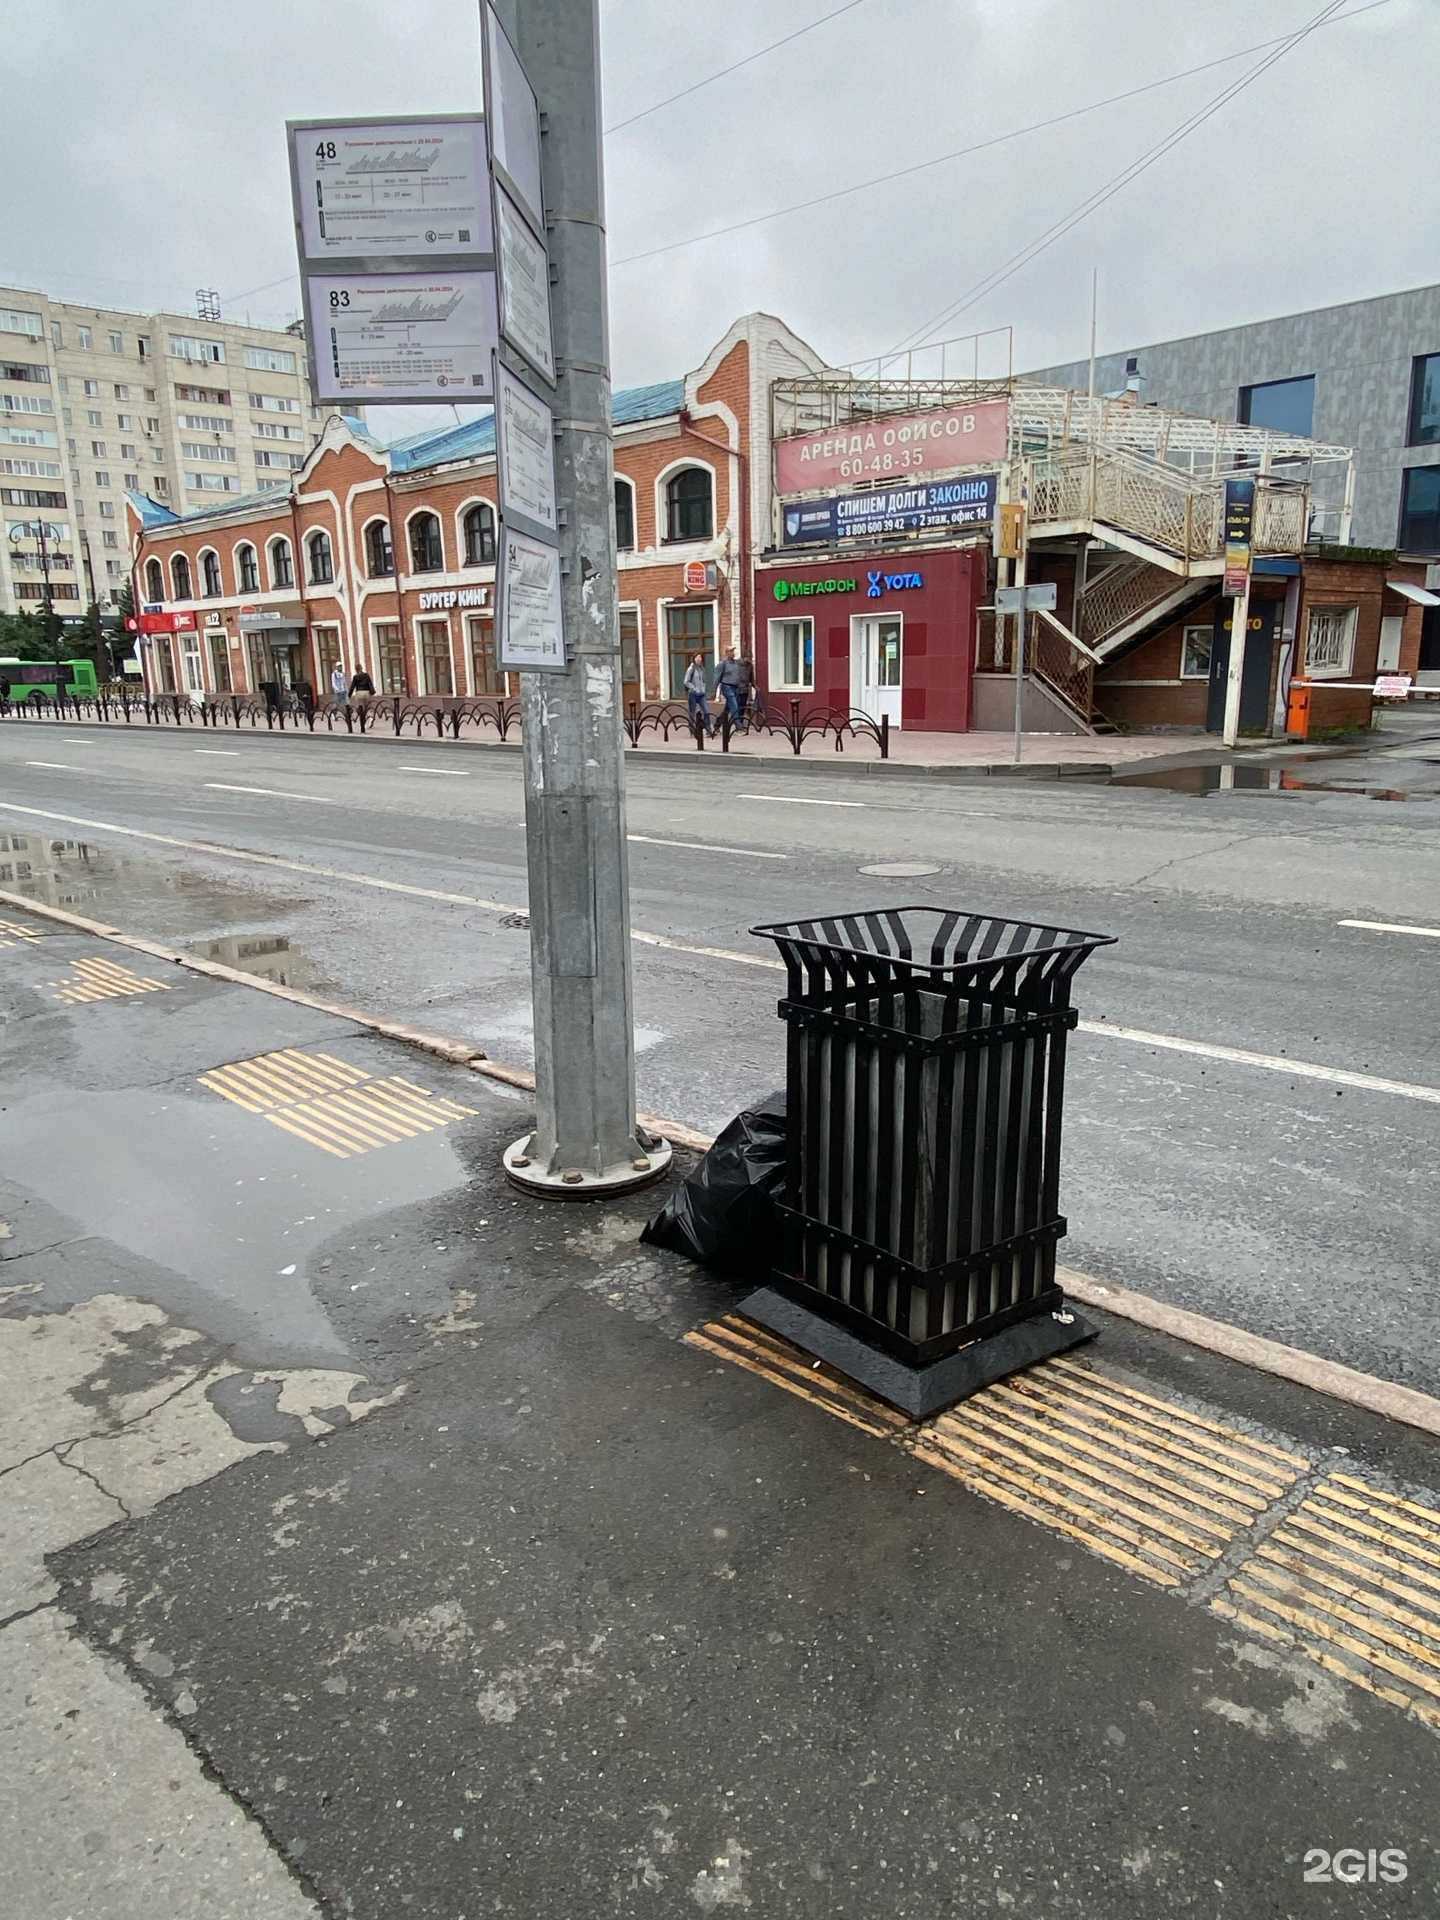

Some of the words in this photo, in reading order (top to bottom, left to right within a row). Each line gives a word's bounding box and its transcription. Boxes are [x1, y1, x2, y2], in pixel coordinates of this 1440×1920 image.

[315, 141, 336, 160] 48
[329, 290, 350, 307] 83
[800, 433, 876, 462] АРЕНДА
[883, 414, 976, 446] ОФИСОВ
[840, 447, 923, 477] 60-48-35
[837, 496, 886, 518] СПИШЕМ
[887, 489, 927, 513] ДОЛГИ
[929, 481, 988, 505] ЗАКОННО
[919, 514, 926, 526] 2
[927, 513, 950, 526] этаж,
[951, 509, 975, 525] офис
[975, 507, 987, 520] 14
[846, 525, 851, 536] 8
[852, 523, 866, 535] 800
[884, 520, 893, 531] 39
[894, 519, 904, 530] 42
[884, 573, 922, 590] YOTA
[419, 591, 457, 609] БУРГЕР
[458, 588, 488, 607] КИНГ
[1223, 617, 1262, 631] ФТО
